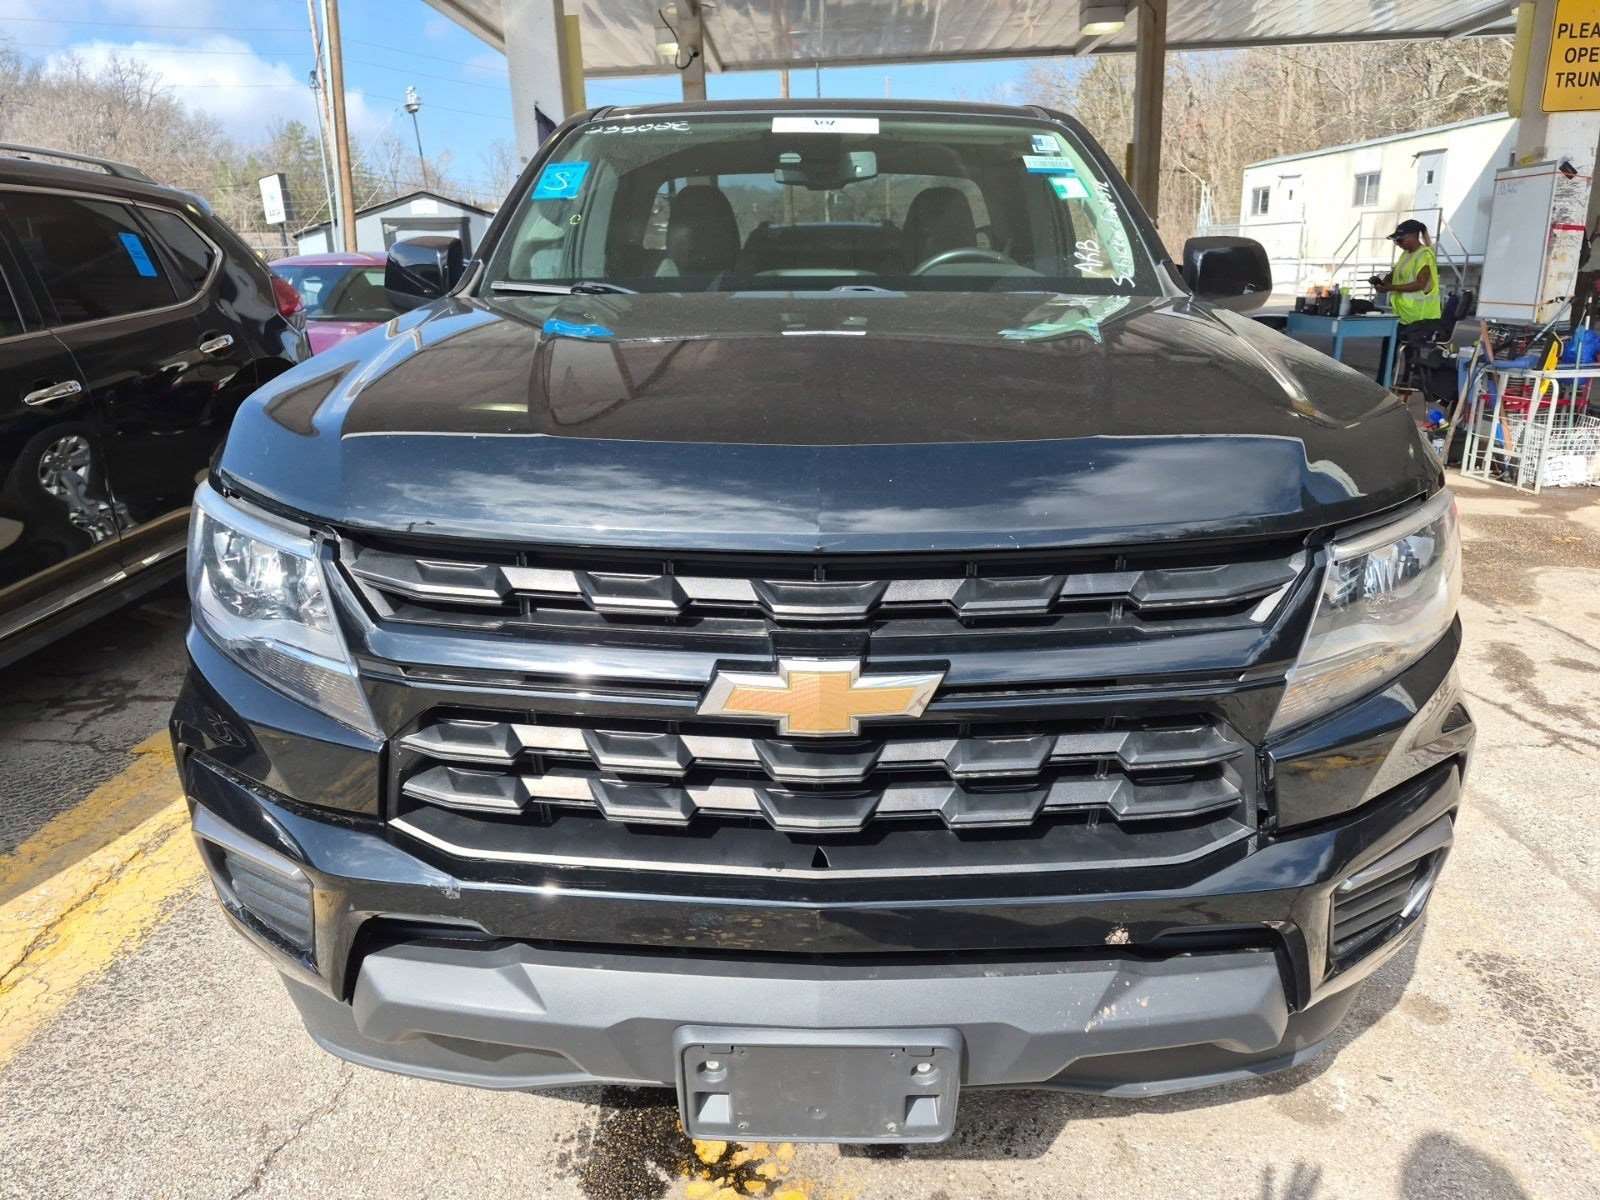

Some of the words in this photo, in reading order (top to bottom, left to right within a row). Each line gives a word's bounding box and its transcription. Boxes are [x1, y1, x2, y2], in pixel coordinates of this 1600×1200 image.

[1557, 22, 1600, 39] PLEA
[1564, 47, 1600, 63] OPE
[1555, 71, 1600, 88] TRUN
